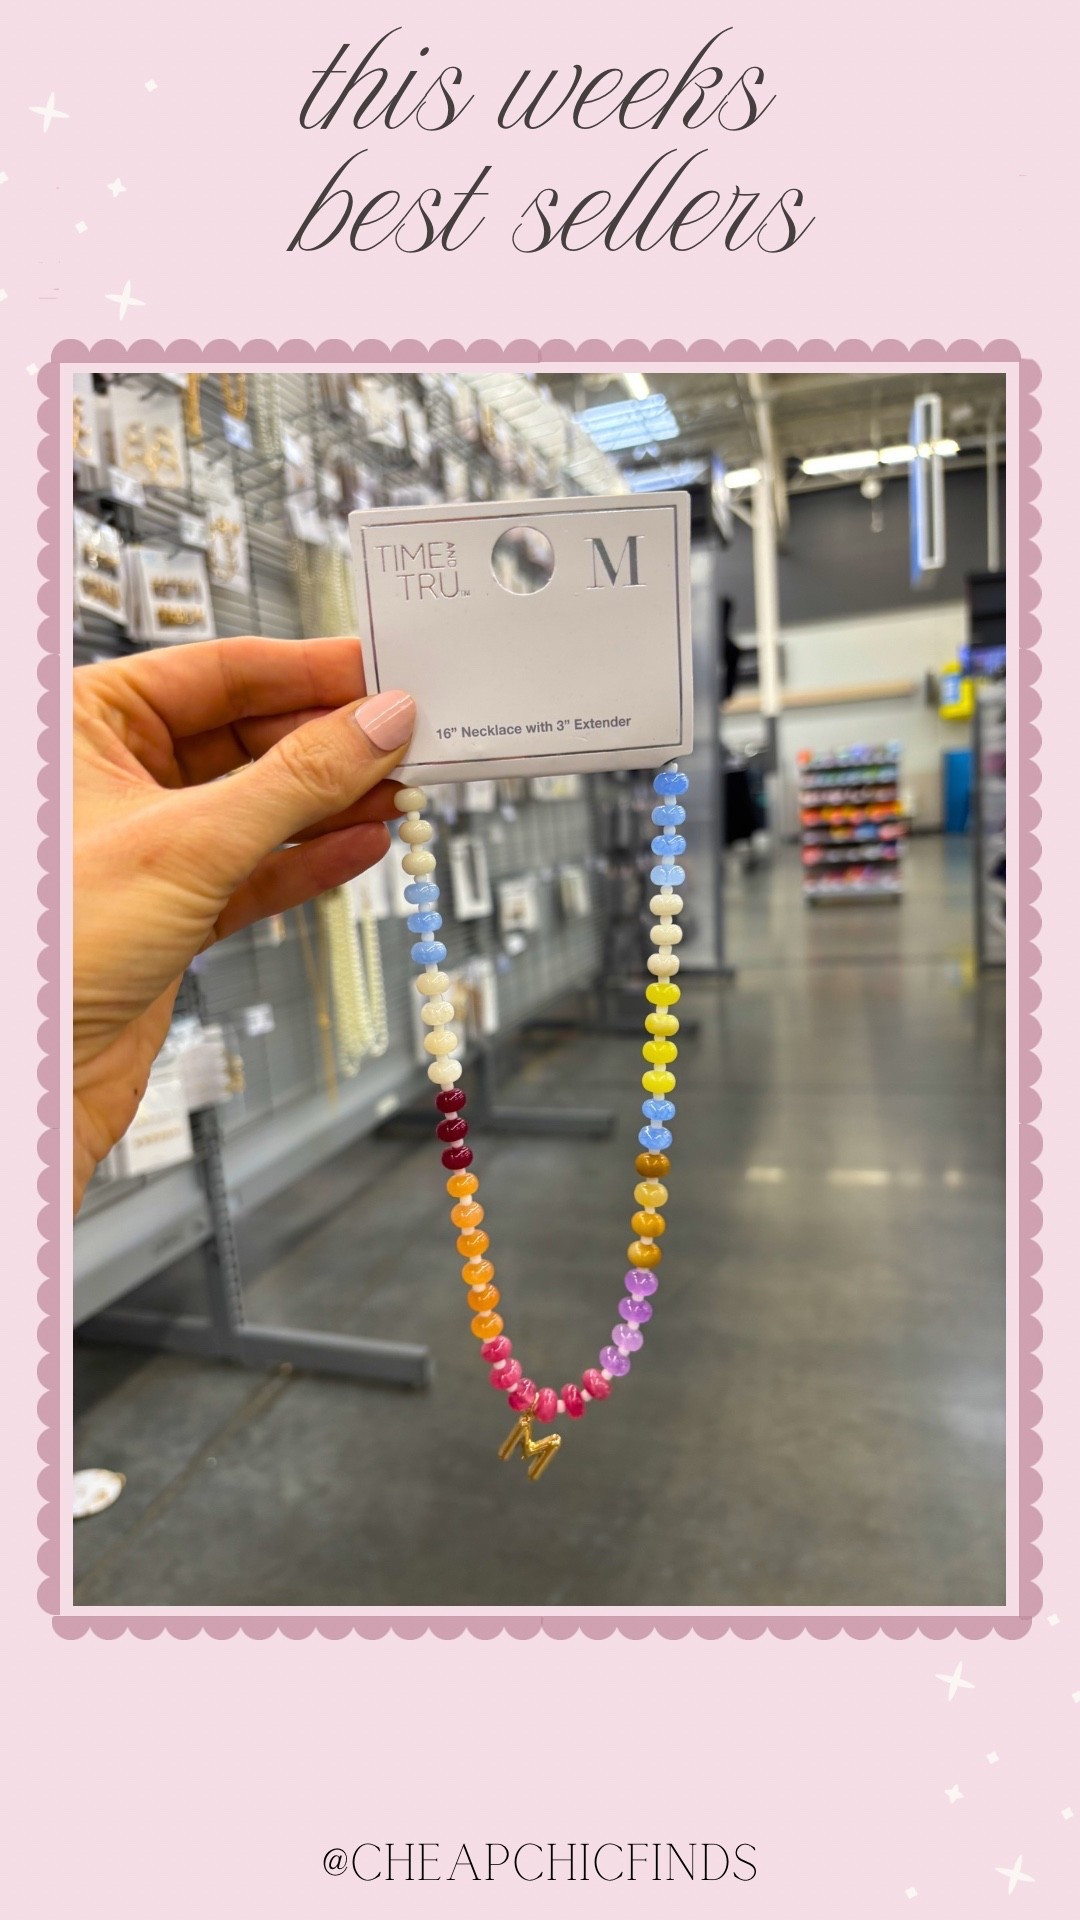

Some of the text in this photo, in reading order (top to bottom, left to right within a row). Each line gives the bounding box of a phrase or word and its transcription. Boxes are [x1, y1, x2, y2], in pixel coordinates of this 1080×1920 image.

[374, 541, 445, 572] TIME
[445, 541, 457, 568] AND
[584, 535, 647, 590] M
[461, 723, 522, 739] Necklace
[526, 720, 553, 734] with
[574, 715, 632, 731] Extender
